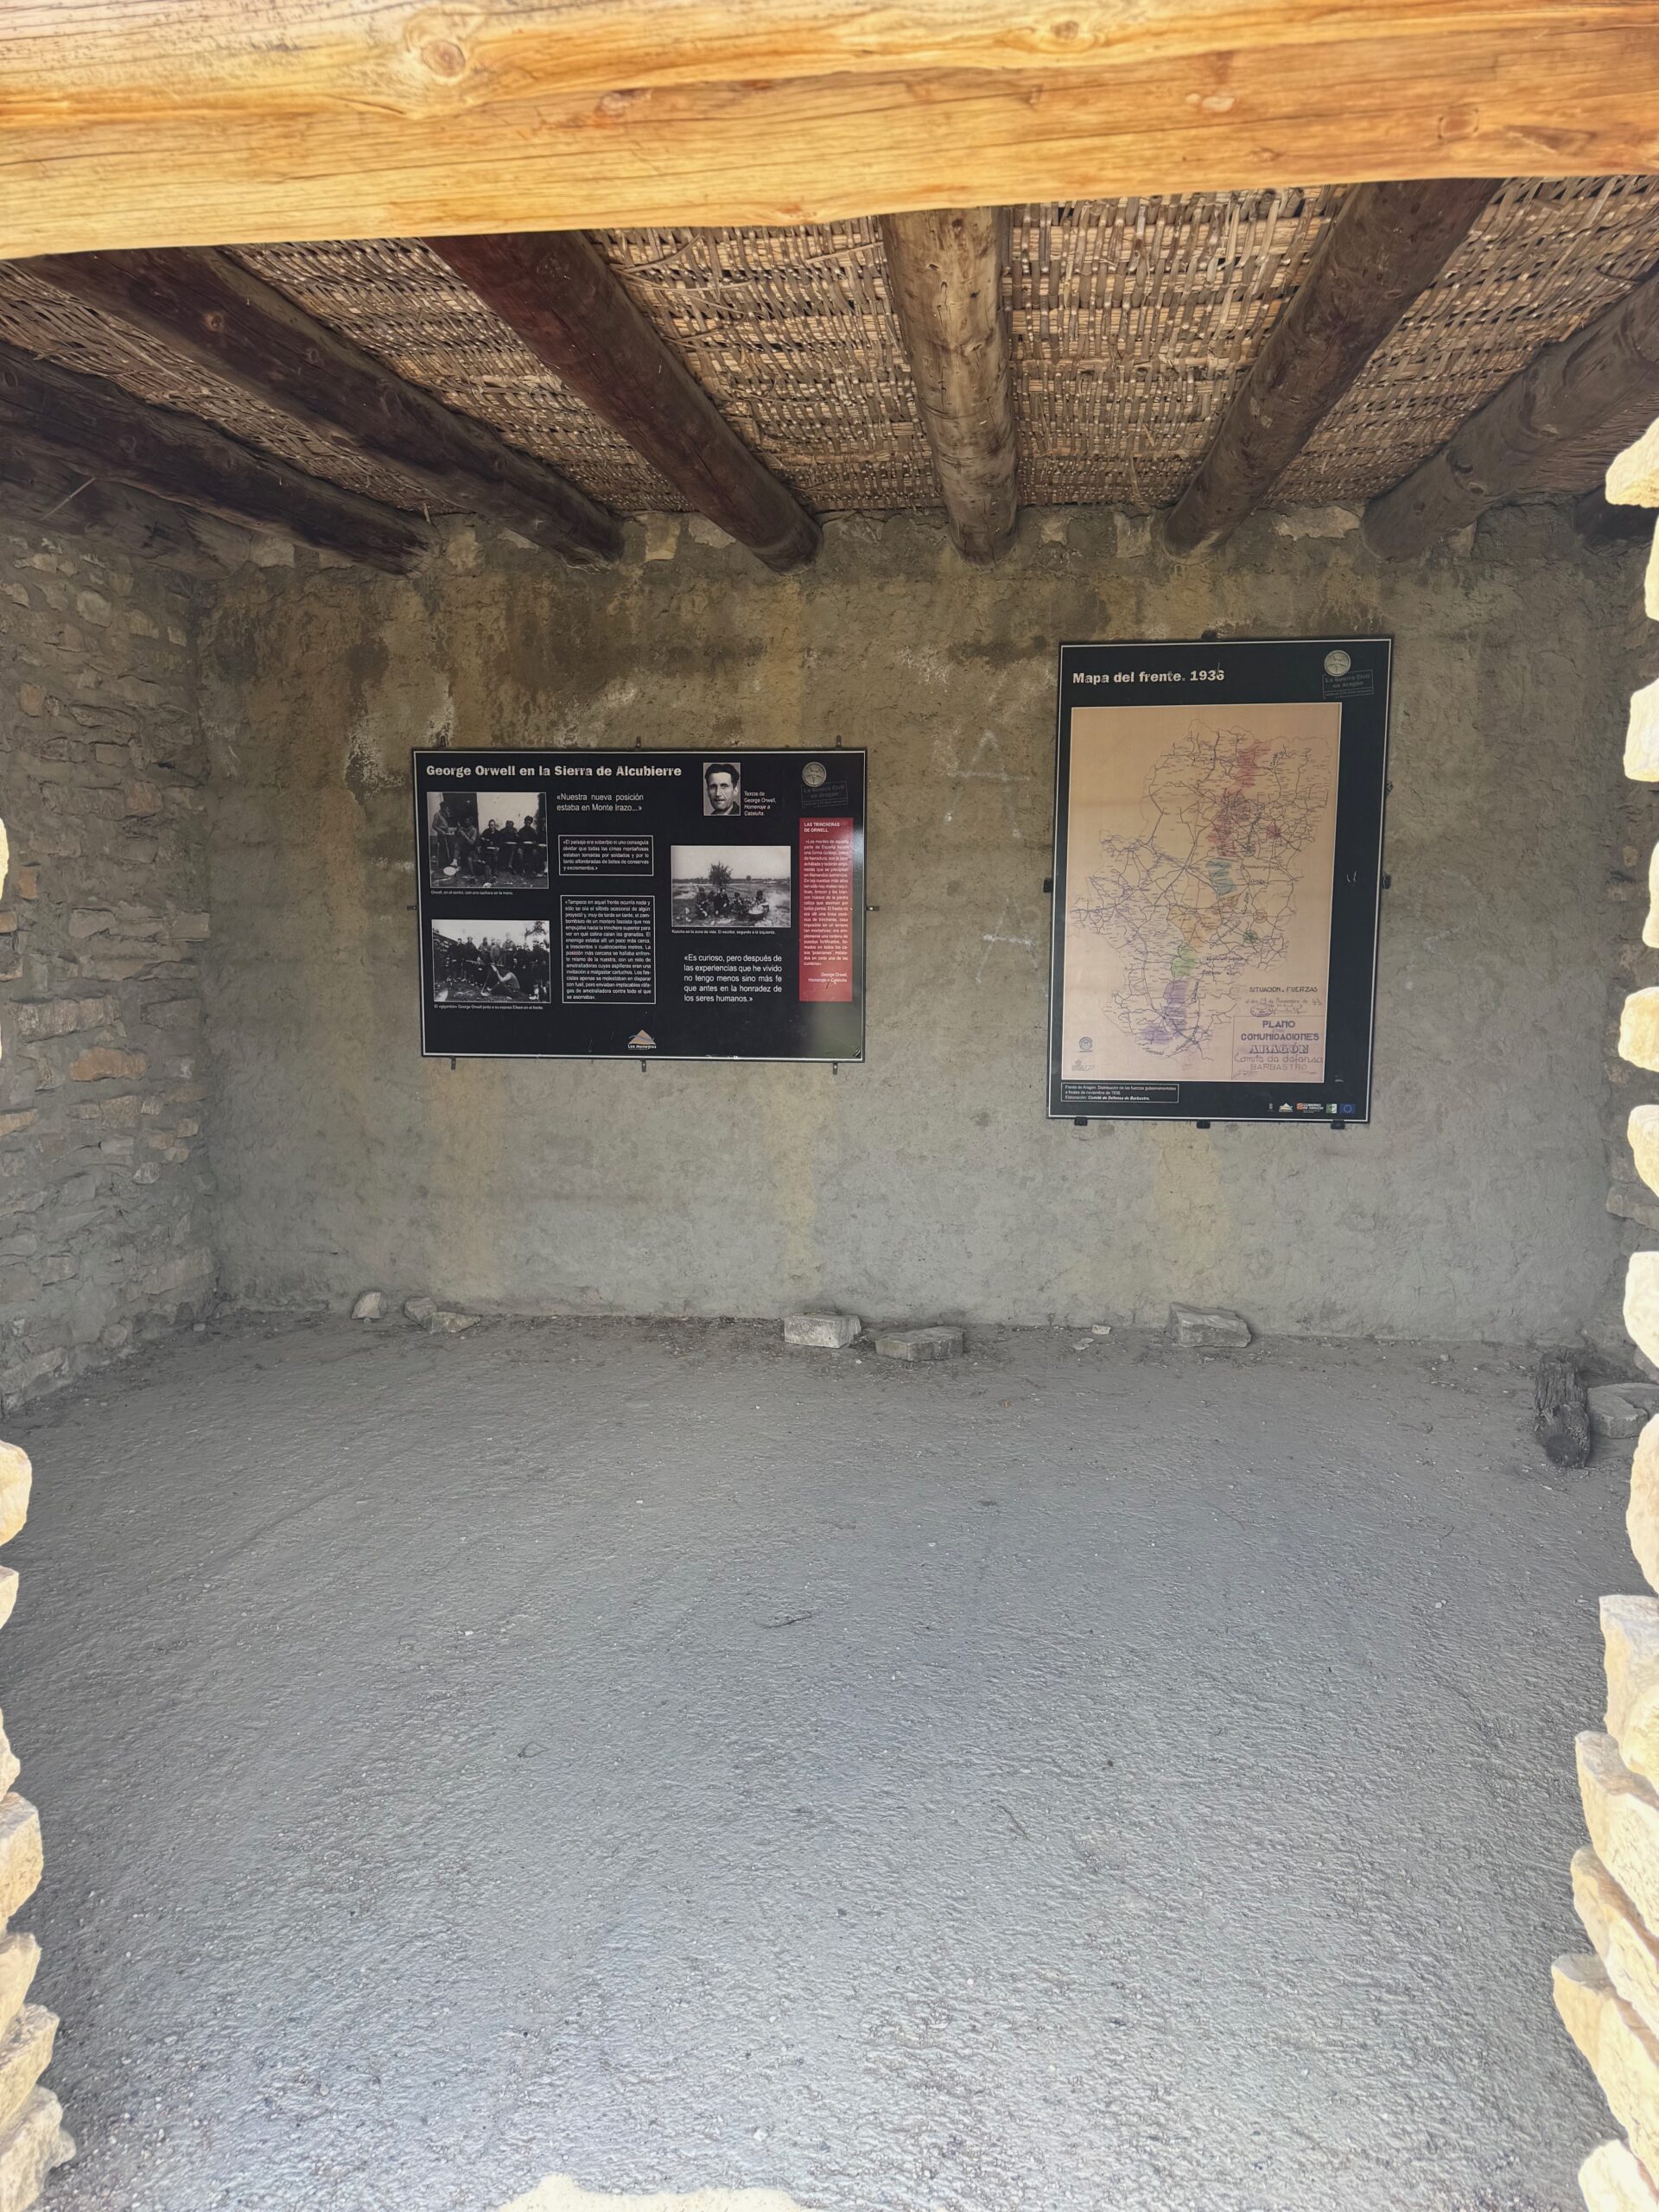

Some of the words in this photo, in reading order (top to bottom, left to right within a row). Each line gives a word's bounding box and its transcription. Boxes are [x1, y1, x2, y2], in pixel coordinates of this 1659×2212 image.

[1073, 672, 1109, 685] Mapa
[1114, 671, 1135, 683] del
[1139, 671, 1185, 683] frente.
[426, 766, 471, 778] George
[475, 766, 516, 776] Orwell
[539, 766, 550, 776] la
[555, 766, 593, 777] Sierra
[596, 766, 612, 777] de
[616, 766, 682, 777] Alcubierre
[616, 792, 644, 802] posición
[695, 964, 737, 973] experiencias
